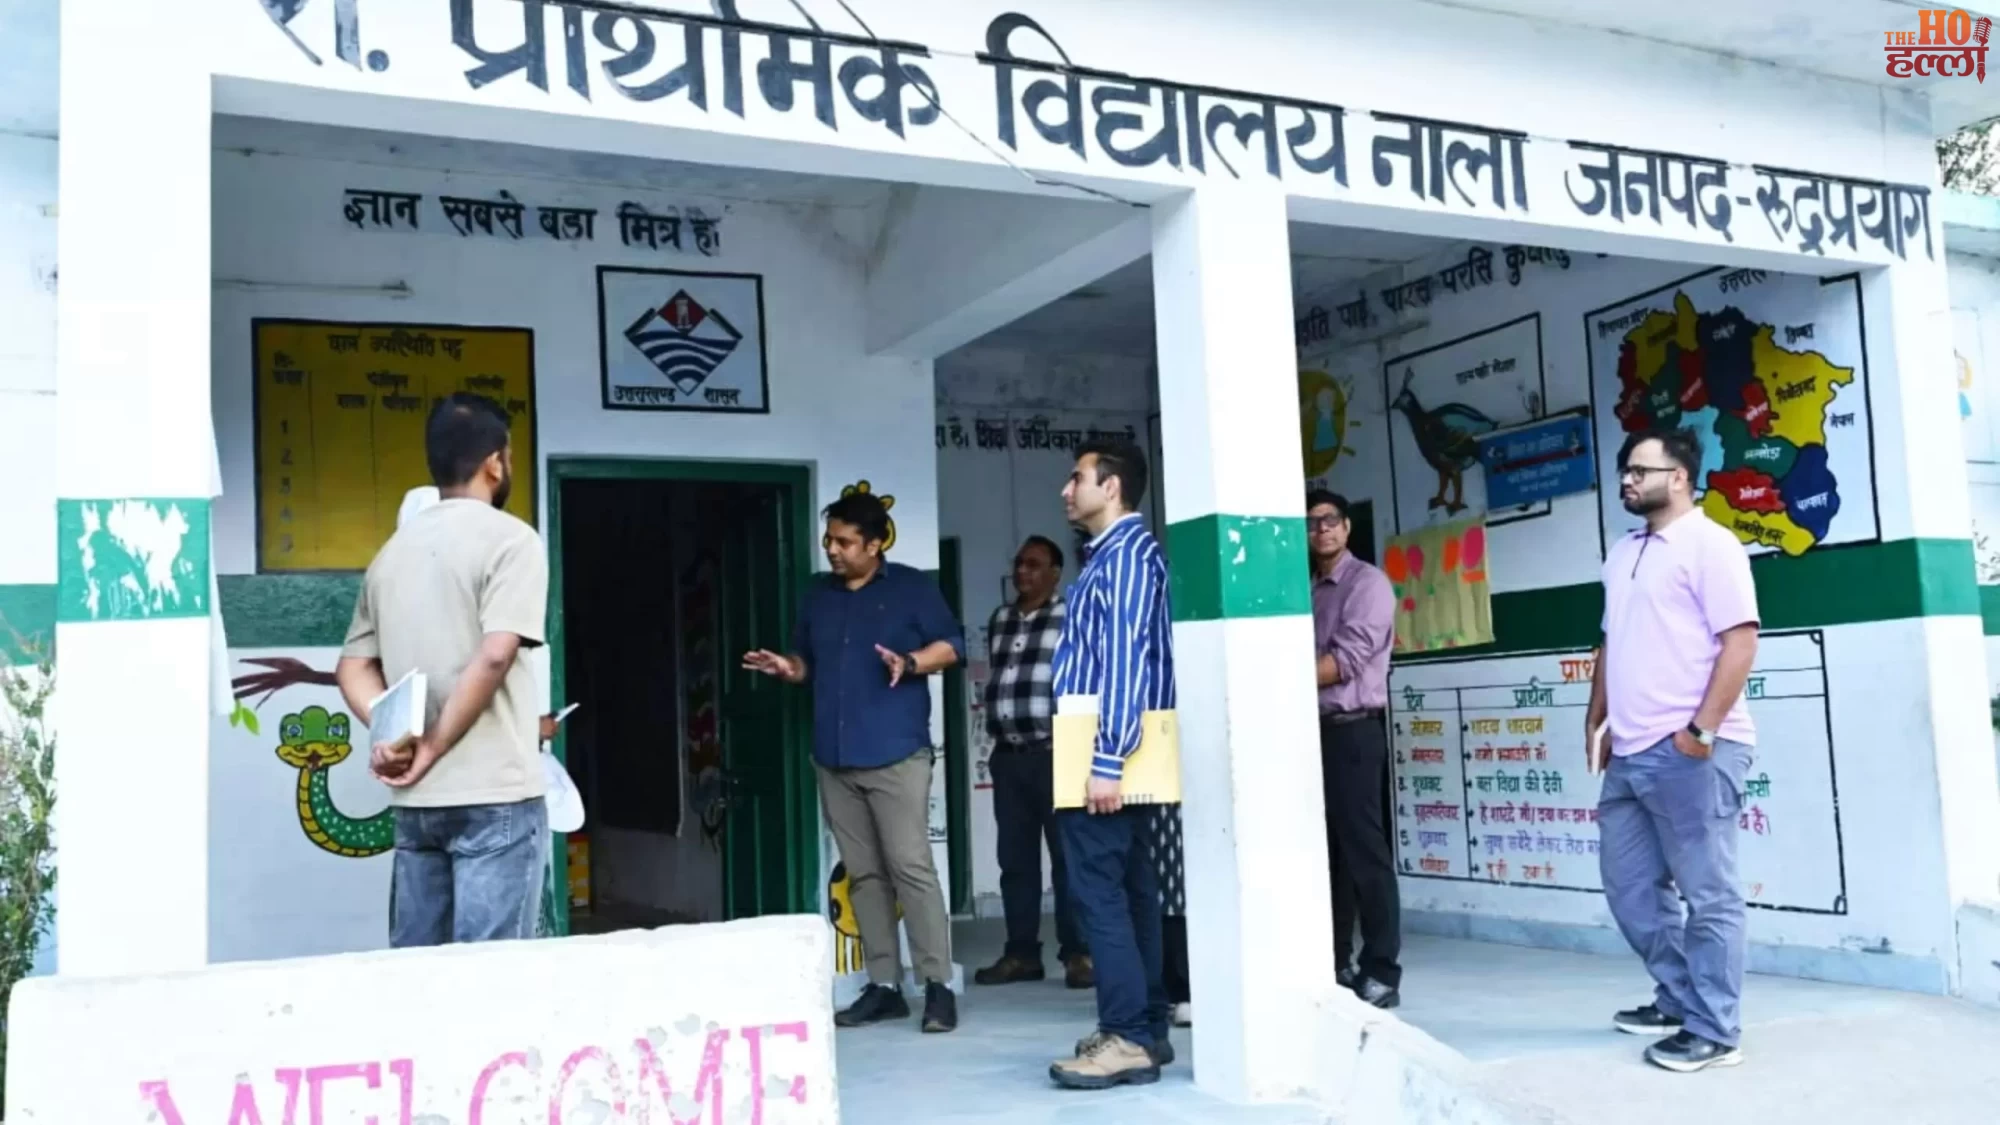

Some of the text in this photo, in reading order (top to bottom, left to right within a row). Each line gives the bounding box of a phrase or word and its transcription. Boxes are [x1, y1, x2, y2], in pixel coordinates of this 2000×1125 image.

[975, 11, 1349, 189] विद्यालय
[1371, 110, 1529, 212] नाला
[343, 188, 422, 230] ज्ञान
[440, 189, 525, 239] सबसे
[616, 200, 682, 251] मित्र
